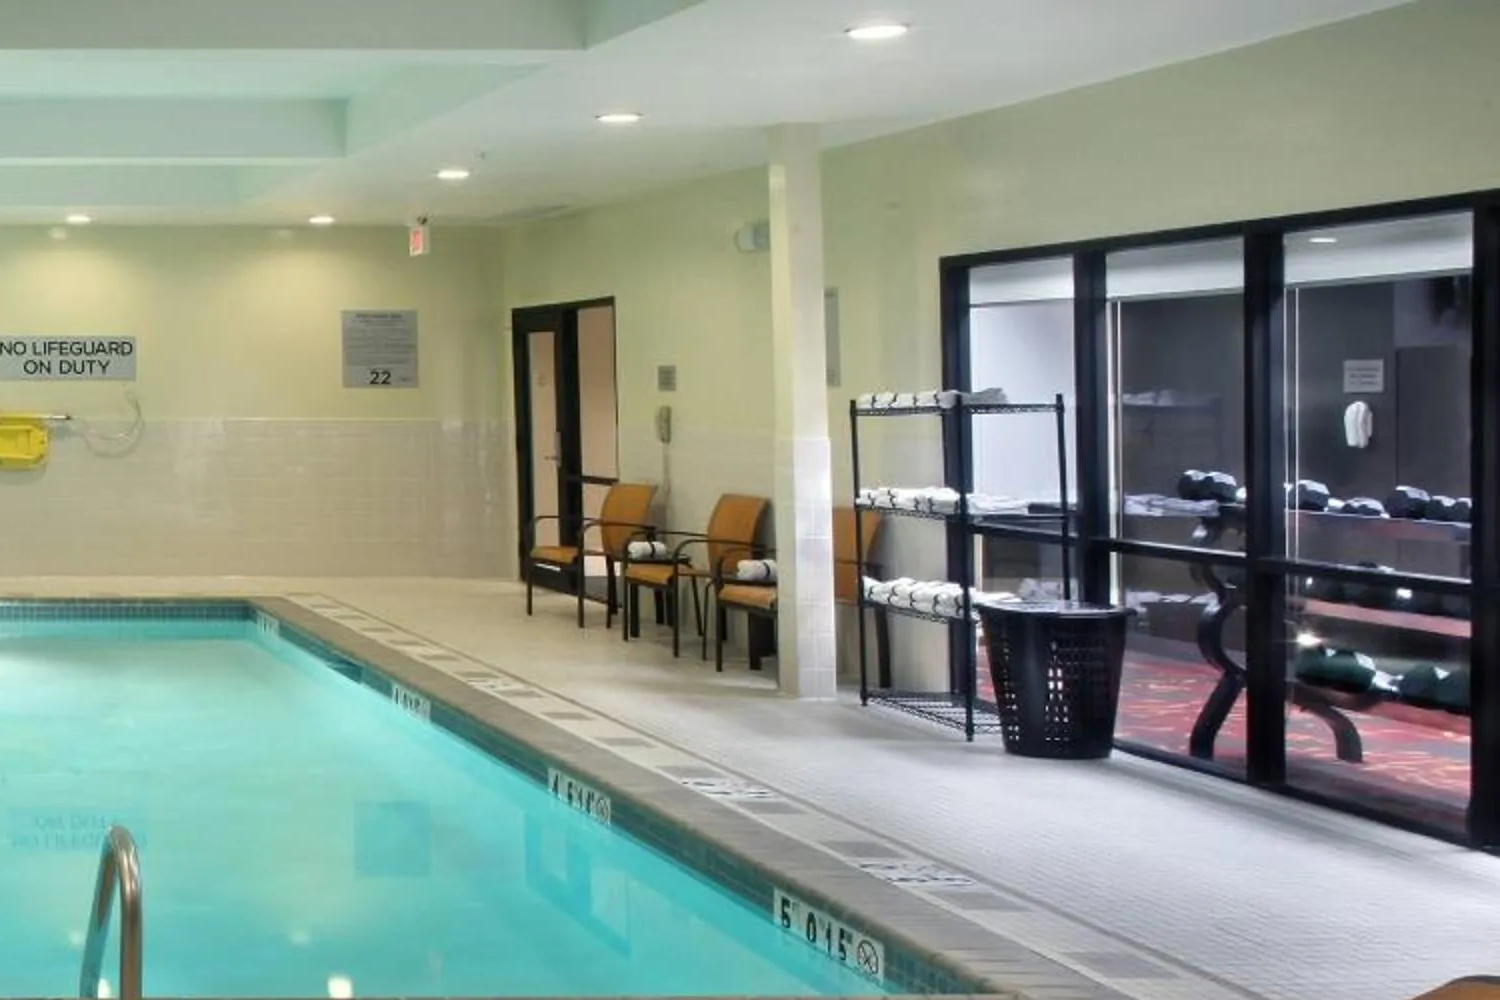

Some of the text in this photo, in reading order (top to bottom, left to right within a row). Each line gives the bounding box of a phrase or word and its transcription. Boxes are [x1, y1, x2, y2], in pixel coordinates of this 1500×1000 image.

[0, 341, 133, 356] NO LIFEGUARD
[23, 360, 110, 375] ON DUTY
[369, 370, 392, 385] 22
[781, 895, 791, 929] 5
[806, 911, 817, 943] 0
